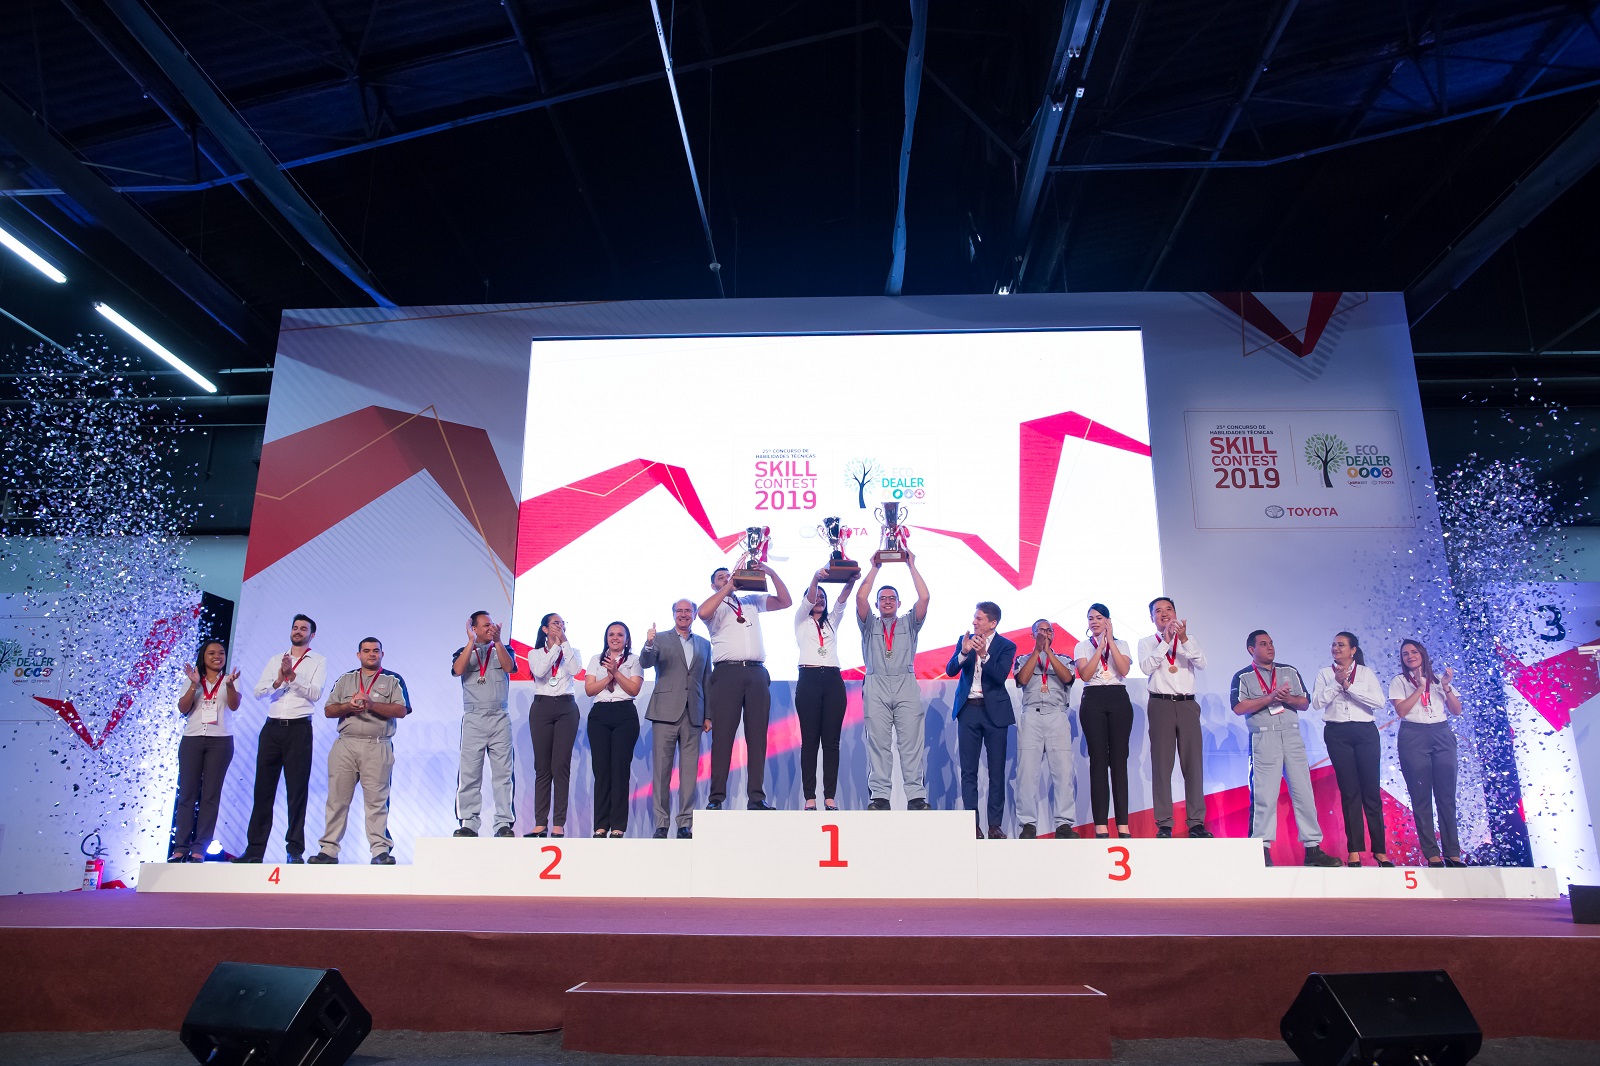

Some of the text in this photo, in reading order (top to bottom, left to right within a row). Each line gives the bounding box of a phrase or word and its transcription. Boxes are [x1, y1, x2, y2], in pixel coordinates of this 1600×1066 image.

[1210, 436, 1278, 455] SKILL
[1355, 444, 1379, 456] ECO
[755, 460, 818, 477] SKILL
[1211, 455, 1279, 467] CONTEST
[1345, 455, 1392, 467] DEALER
[754, 478, 818, 489] CONTEST
[881, 477, 925, 488] DEALER
[1213, 467, 1281, 489] 2019
[754, 490, 817, 511] 2019
[1287, 507, 1339, 517] TOYOTA
[1538, 604, 1566, 642] 3
[27, 647, 47, 657] ECO
[16, 657, 54, 667] DEALER
[818, 824, 849, 868] 1
[538, 845, 563, 880] 2
[1107, 846, 1132, 881] 3
[267, 867, 281, 884] 4
[1404, 870, 1418, 889] 5
